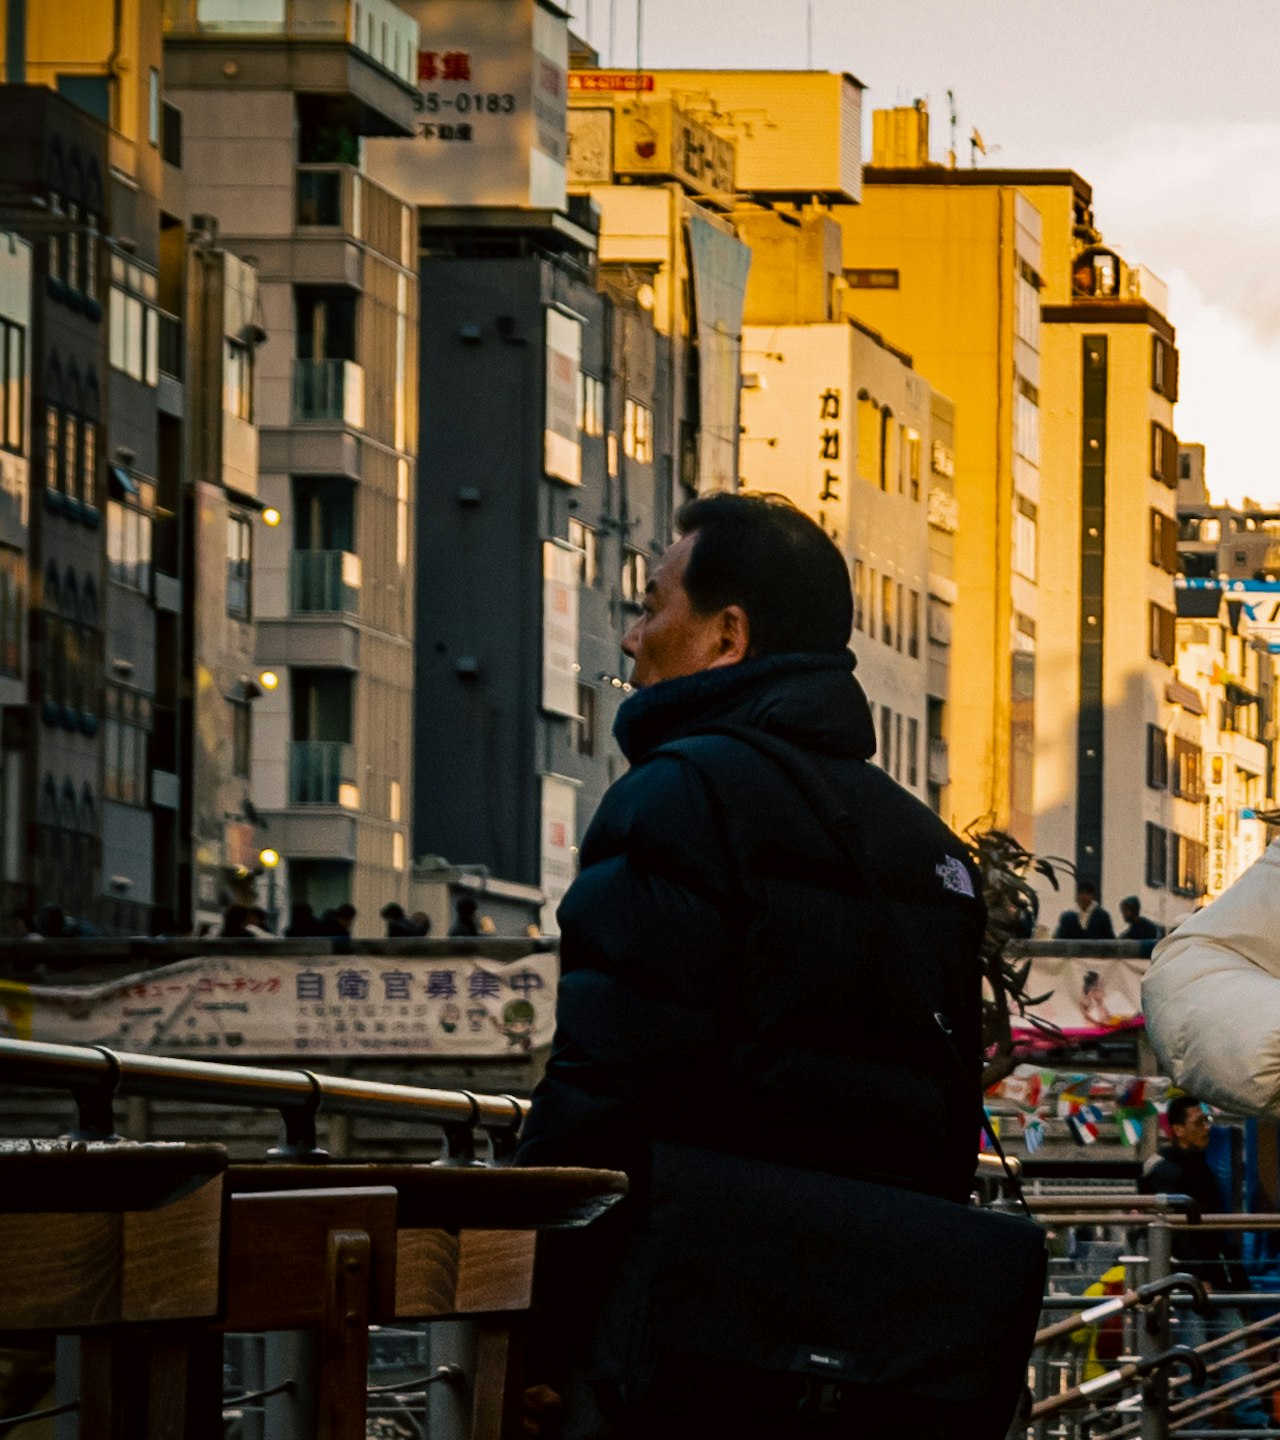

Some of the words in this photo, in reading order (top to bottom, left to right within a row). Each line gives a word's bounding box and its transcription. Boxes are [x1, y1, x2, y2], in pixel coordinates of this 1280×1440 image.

[297, 969, 545, 1000] 自衛官募集中
